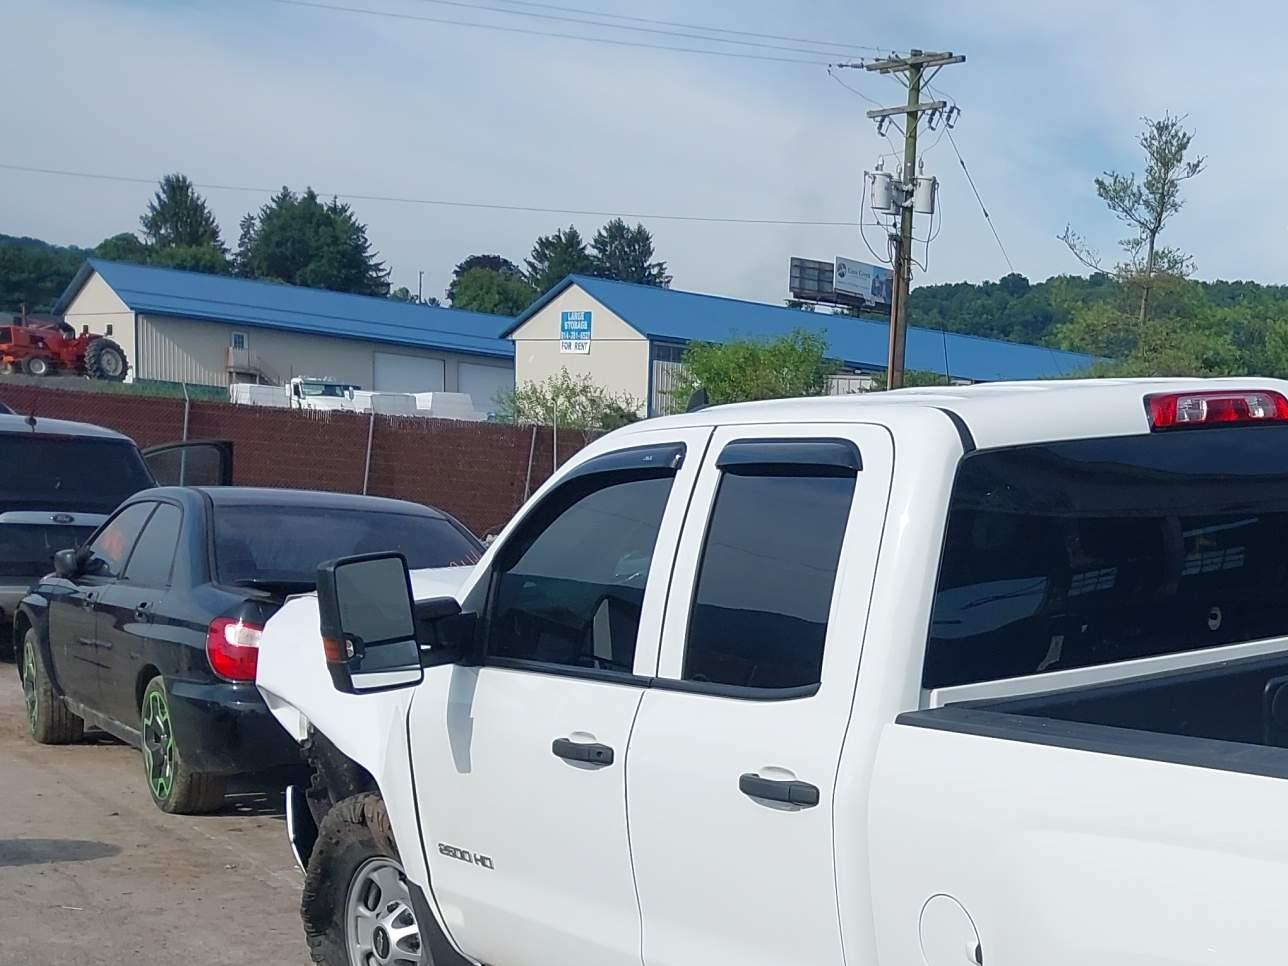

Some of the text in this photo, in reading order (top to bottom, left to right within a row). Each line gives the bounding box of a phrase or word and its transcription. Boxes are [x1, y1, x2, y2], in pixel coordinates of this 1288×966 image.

[564, 320, 588, 330] STORAGE
[561, 341, 589, 351] FOR RENT
[438, 842, 495, 870] 2500 HD
